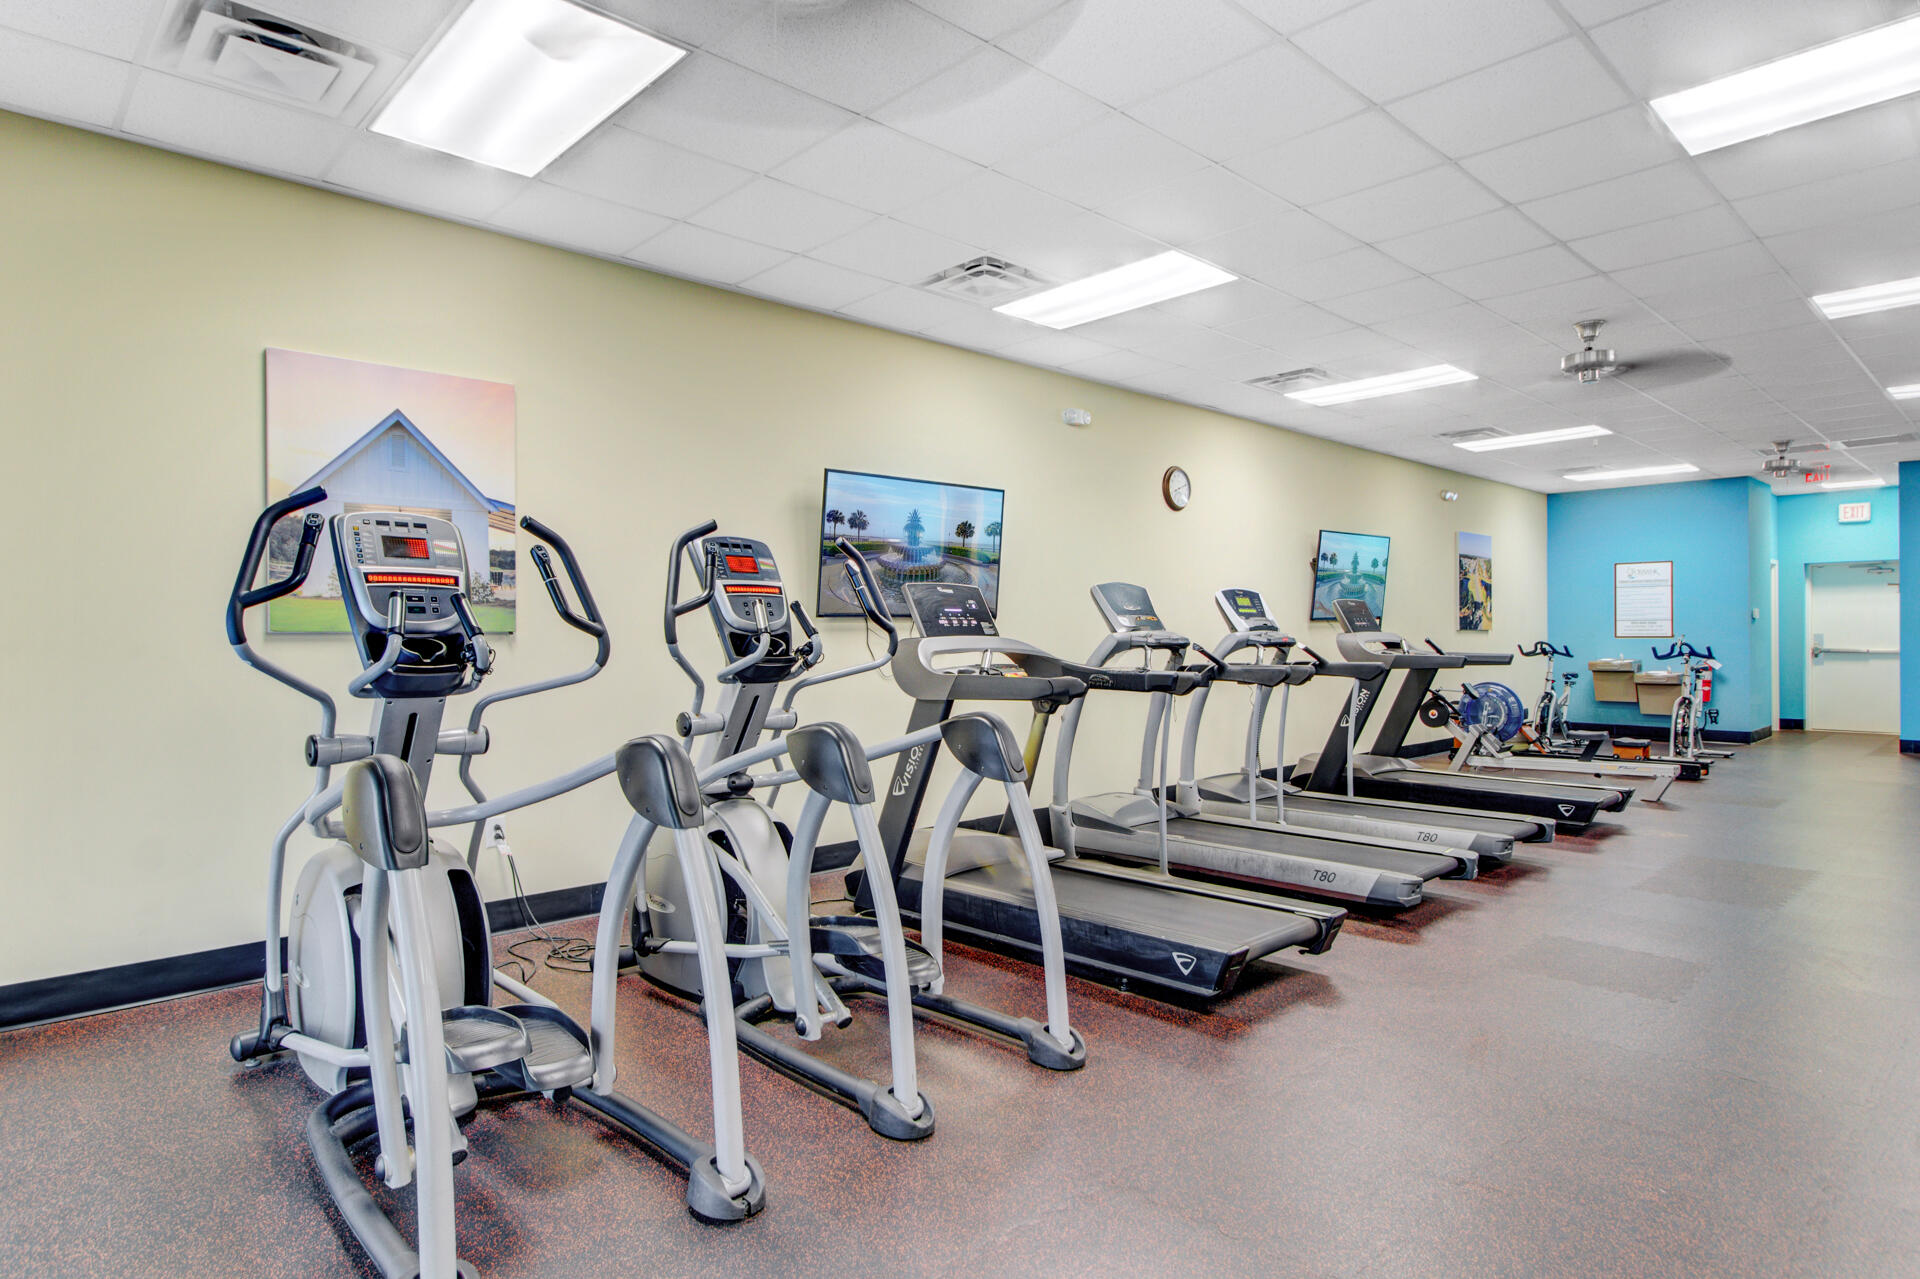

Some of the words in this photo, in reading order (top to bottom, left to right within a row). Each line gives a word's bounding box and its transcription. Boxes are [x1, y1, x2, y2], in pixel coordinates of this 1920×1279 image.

[1843, 505, 1865, 520] EXIT
[902, 745, 921, 787] VISIO
[1416, 831, 1438, 843] T80
[1312, 869, 1337, 883] T80
